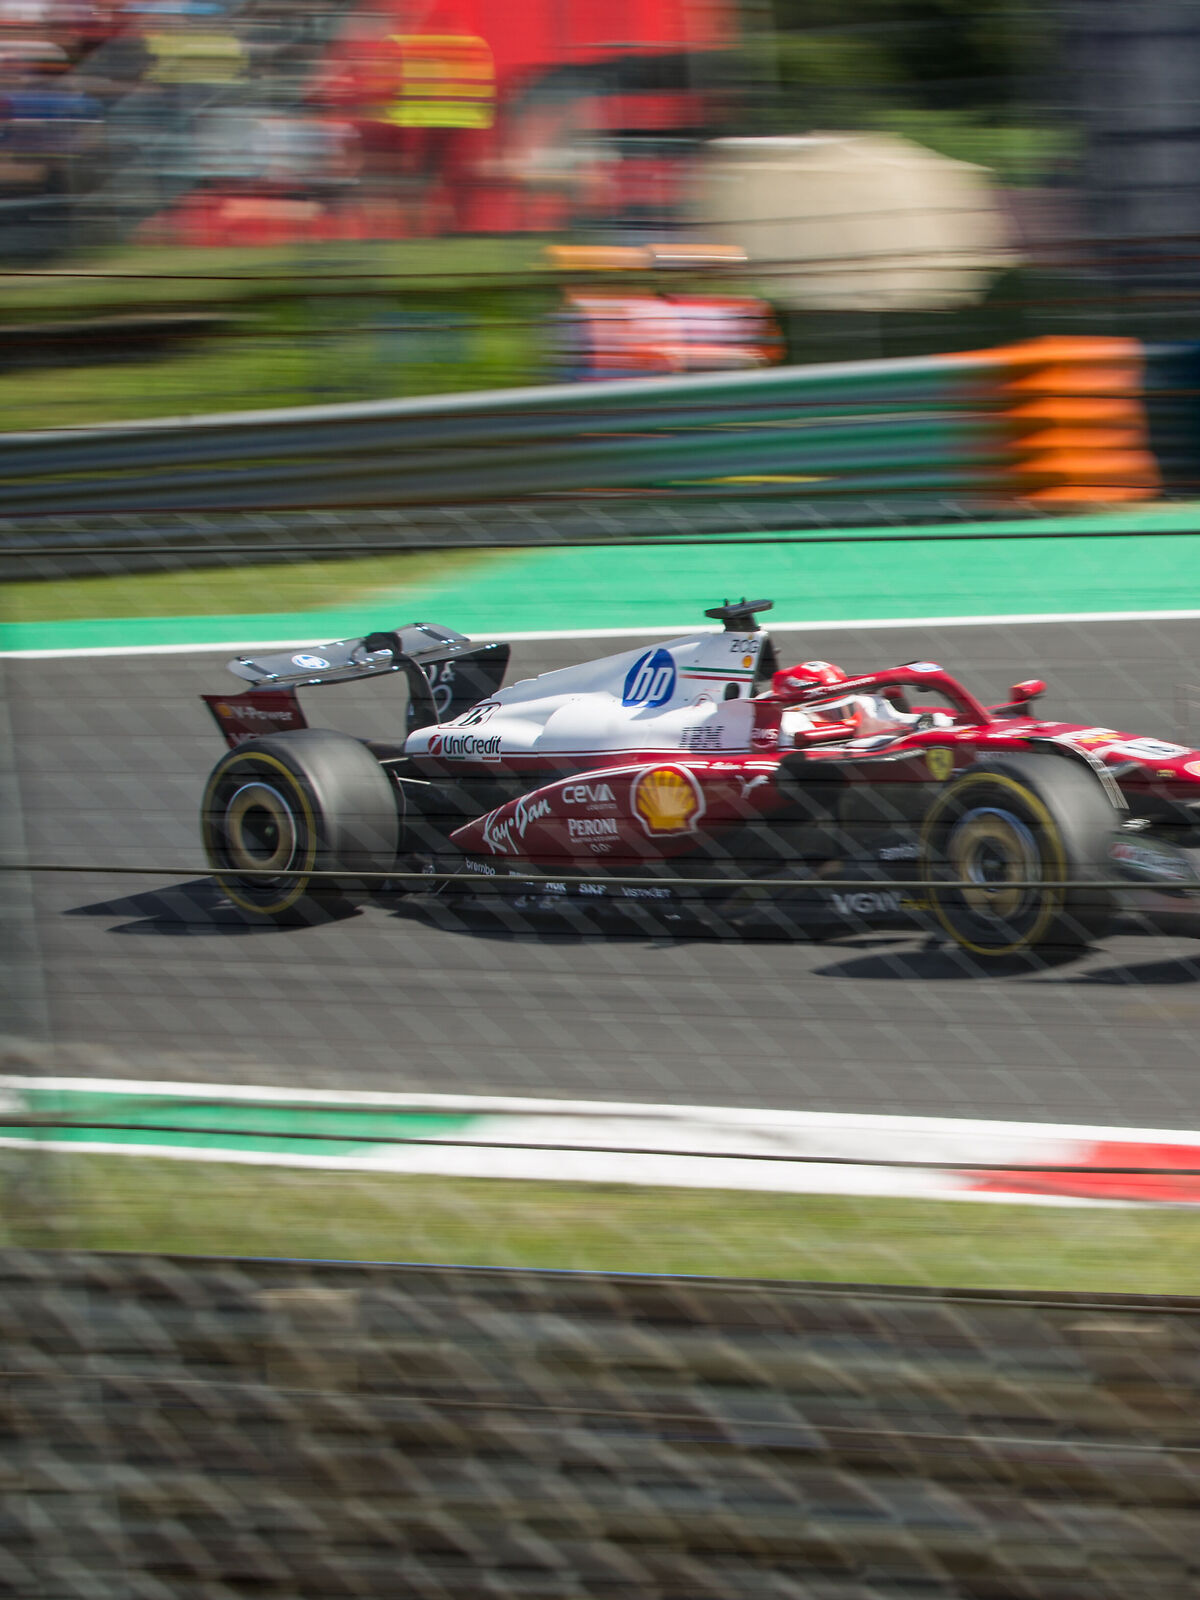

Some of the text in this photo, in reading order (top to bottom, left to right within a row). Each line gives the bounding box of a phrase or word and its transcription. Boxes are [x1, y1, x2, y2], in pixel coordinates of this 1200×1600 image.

[625, 648, 674, 707] hp
[444, 735, 502, 755] UniCredit
[568, 818, 618, 837] PERONI
[465, 857, 496, 876] brembo
